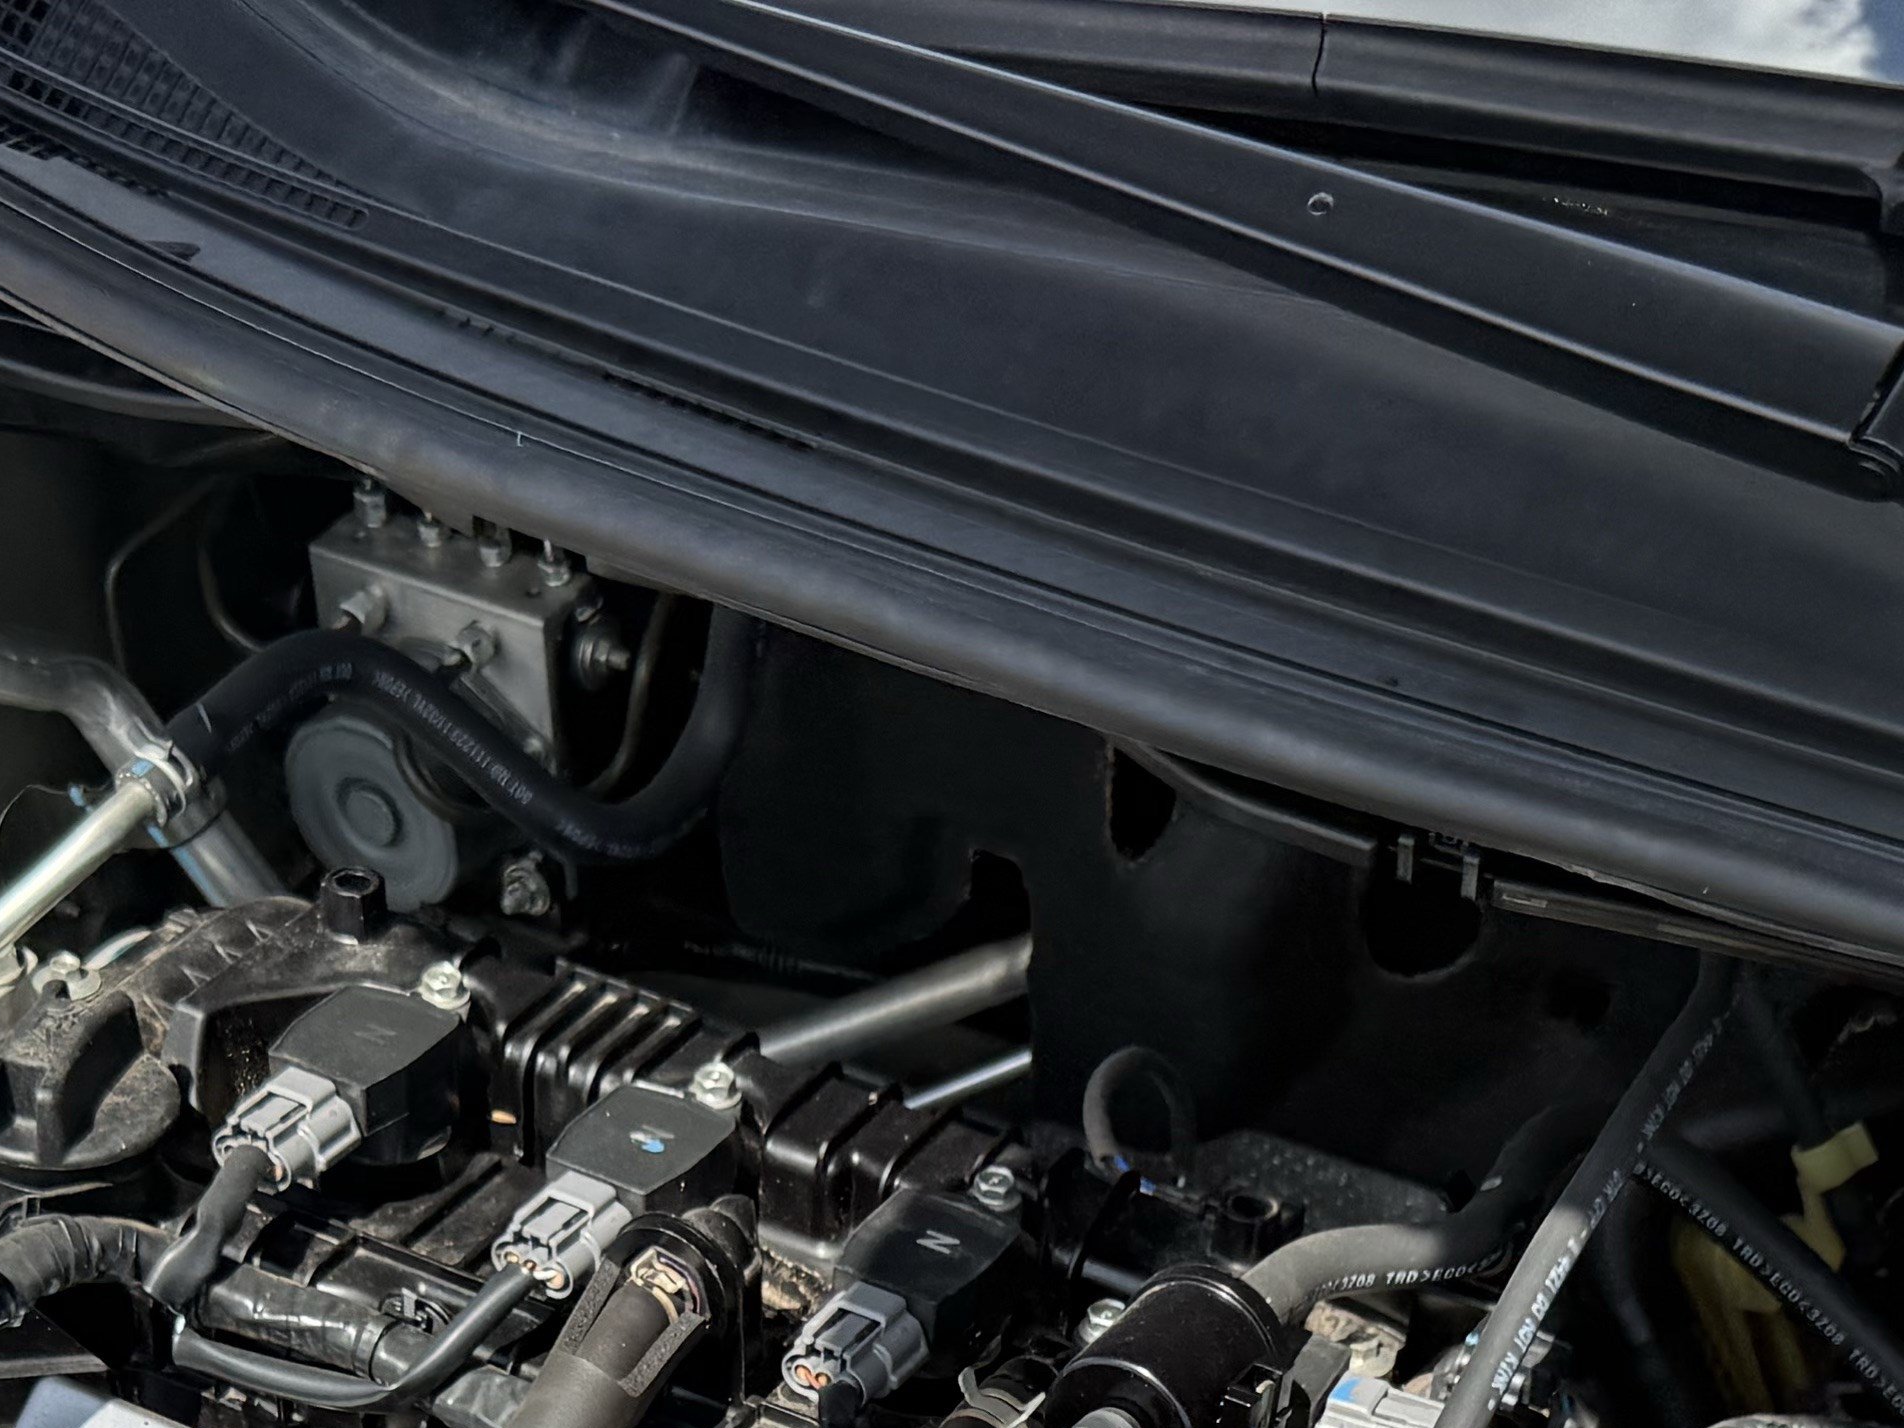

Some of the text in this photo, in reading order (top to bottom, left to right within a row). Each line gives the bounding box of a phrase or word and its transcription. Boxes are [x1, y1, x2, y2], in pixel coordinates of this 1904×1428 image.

[1527, 1292, 1552, 1321] DO
[1511, 1316, 1539, 1352] NOT
[1488, 1349, 1521, 1395] KINK
